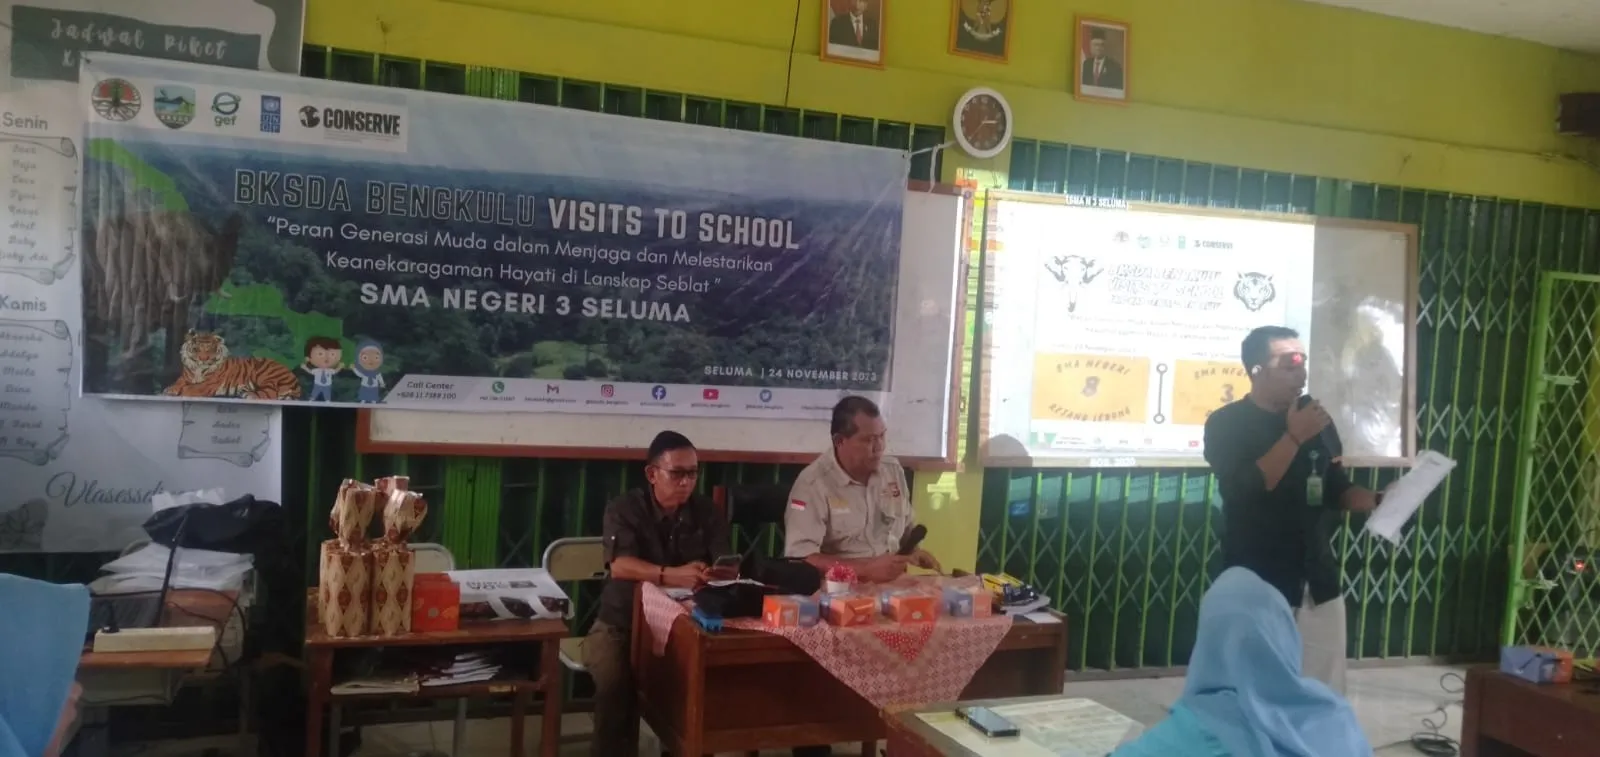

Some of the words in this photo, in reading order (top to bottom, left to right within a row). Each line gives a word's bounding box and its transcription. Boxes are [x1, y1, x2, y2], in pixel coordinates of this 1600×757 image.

[50, 17, 145, 51] Jadwal
[2, 111, 48, 132] Senin
[214, 114, 237, 127] gef
[323, 107, 401, 136] CONSERVE
[234, 168, 352, 212] BKSDA
[366, 180, 536, 227] BENGKULU
[548, 198, 642, 237] VISITS
[654, 207, 688, 240] TO
[699, 212, 800, 250] SCHOOL
[267, 215, 334, 238] “Peran
[340, 223, 428, 246] Generasi
[434, 231, 487, 250] Muda
[493, 231, 550, 255] dalam
[554, 239, 631, 265] Menjaga
[636, 247, 668, 265] dan
[672, 251, 773, 273] Melestarikan
[326, 250, 494, 281] Keanekaragaman
[500, 263, 556, 286] Hayati
[561, 268, 578, 285] di
[584, 271, 652, 293] Lanskap
[656, 275, 710, 294] Seblat
[0, 294, 48, 312] Kamis
[360, 282, 431, 308] SMA
[443, 288, 545, 315] NEGERI
[555, 296, 571, 316] 3
[582, 297, 691, 323] SELUMA
[703, 365, 753, 378] SELUMA
[768, 367, 783, 378] 24
[786, 368, 849, 381] NOVEMBER
[406, 379, 424, 390] Call
[425, 381, 455, 391] Center
[1080, 375, 1101, 398] 8
[1220, 383, 1235, 403] 3
